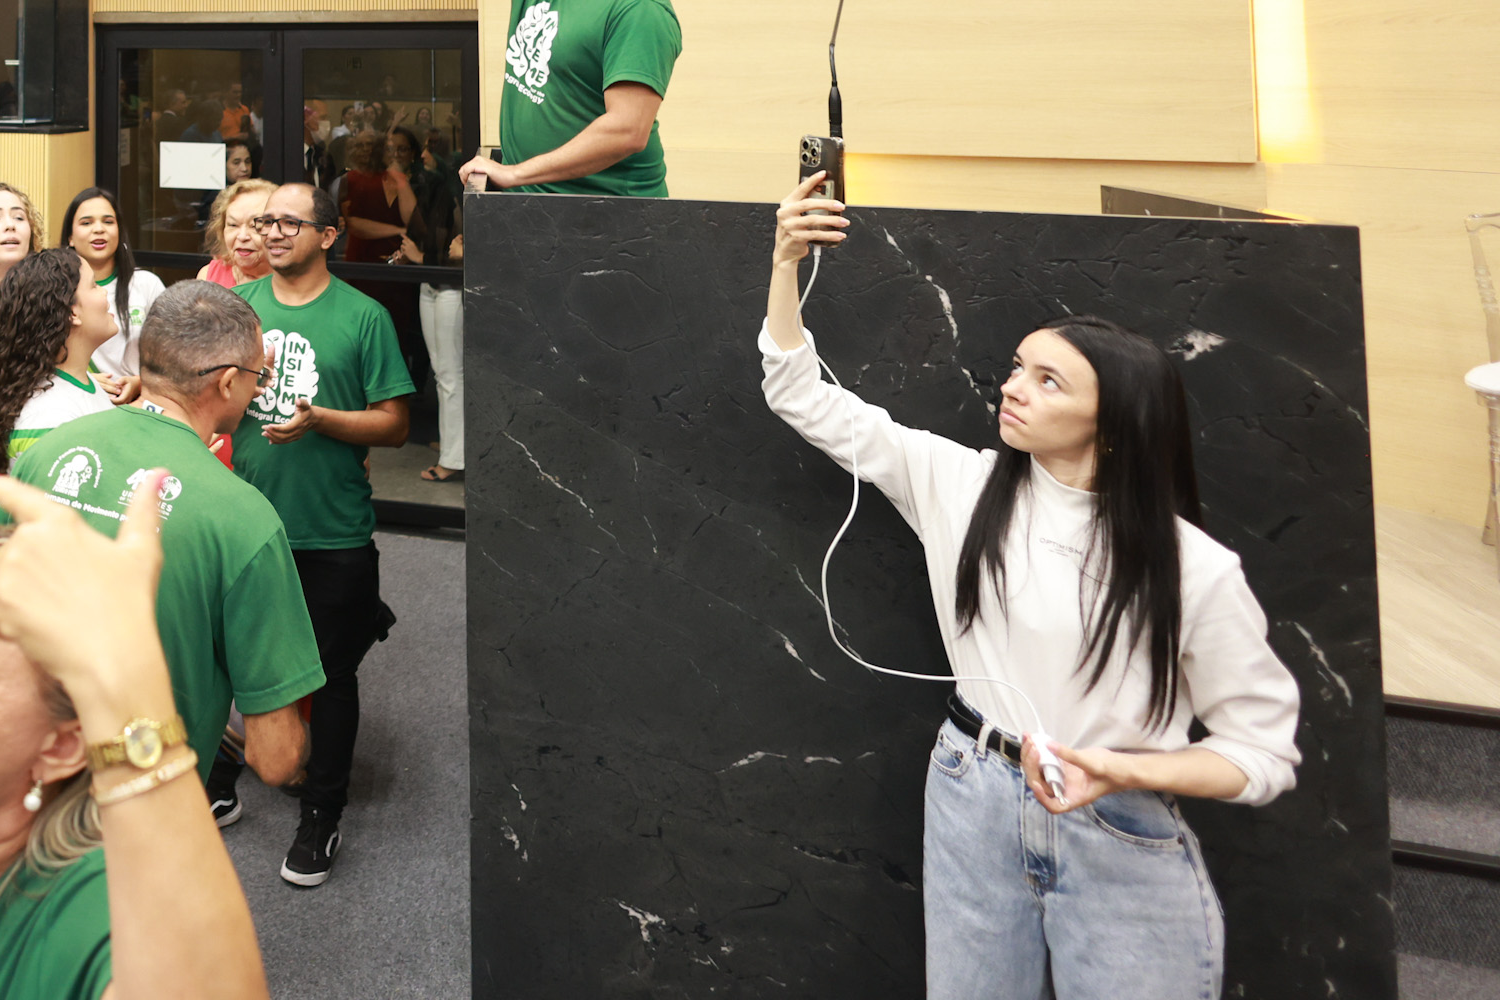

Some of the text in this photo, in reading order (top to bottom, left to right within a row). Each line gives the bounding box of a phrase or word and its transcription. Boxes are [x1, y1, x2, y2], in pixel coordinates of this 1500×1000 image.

[289, 341, 307, 355] IN
[286, 358, 302, 372] SI
[284, 374, 295, 388] E
[246, 408, 292, 425] Integral Eco
